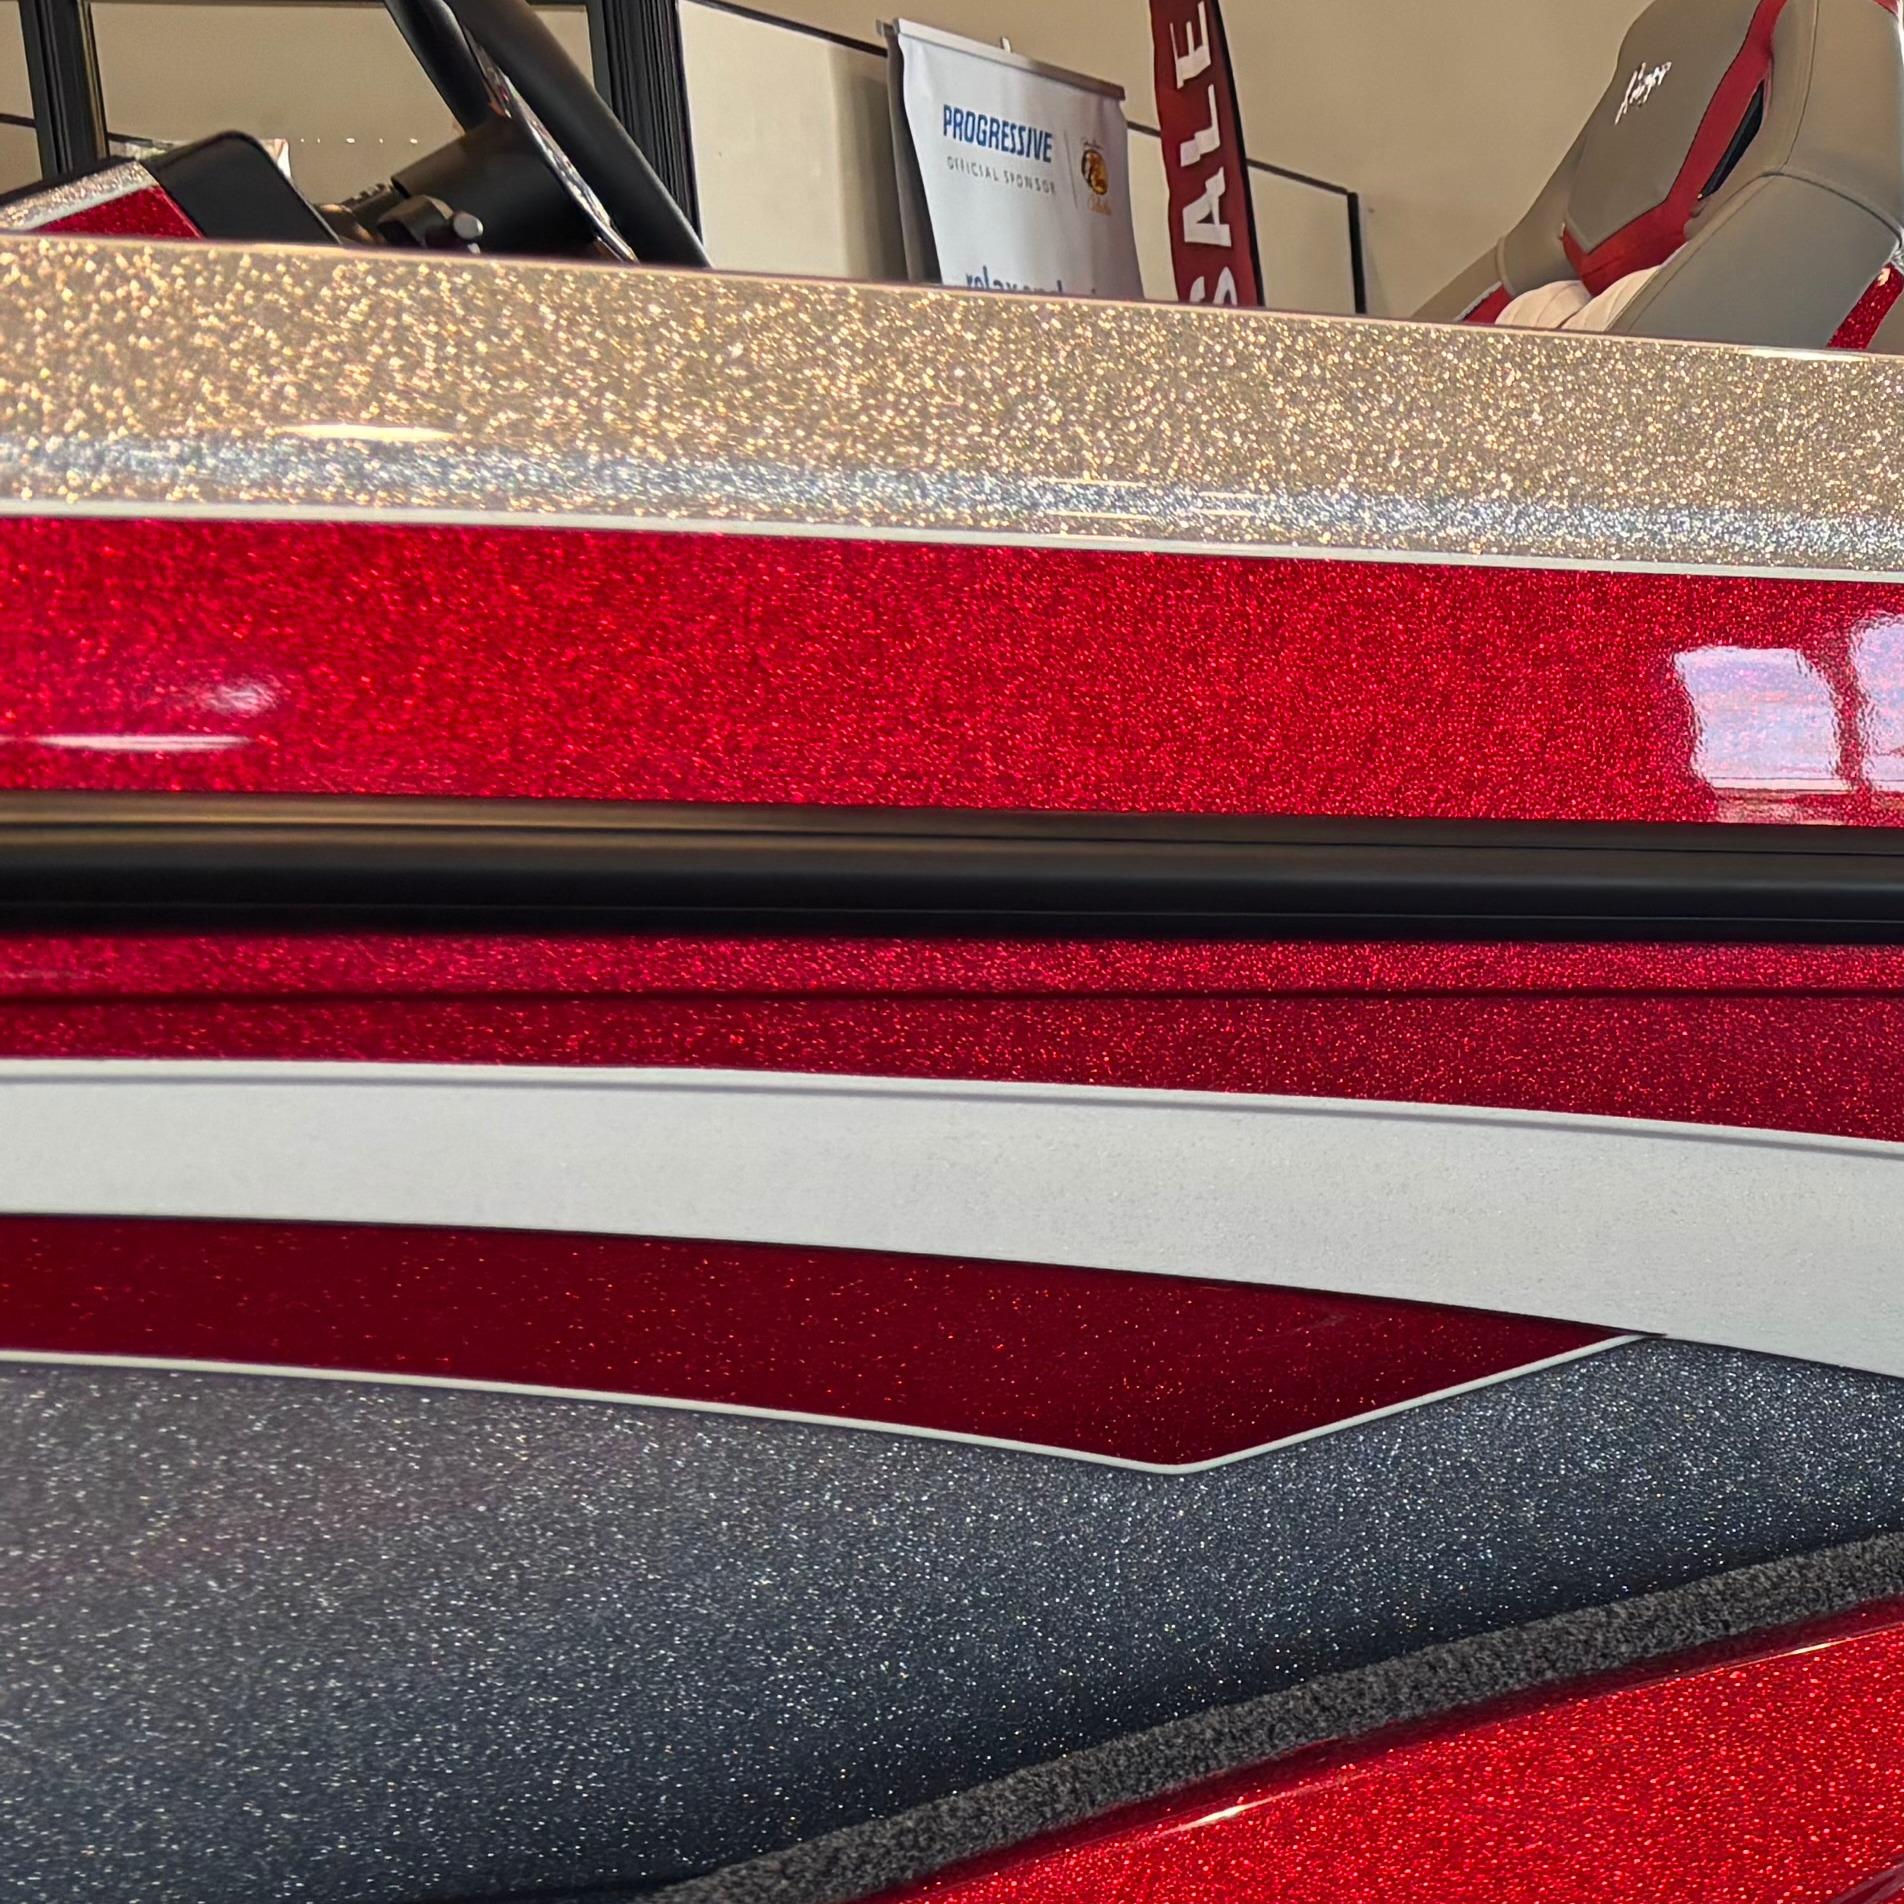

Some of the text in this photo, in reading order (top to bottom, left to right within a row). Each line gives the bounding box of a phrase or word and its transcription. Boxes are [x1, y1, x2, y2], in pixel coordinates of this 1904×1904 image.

[943, 104, 1053, 163] PROGRESSIVE
[947, 156, 1056, 196] OFFICIAL SPONSOR
